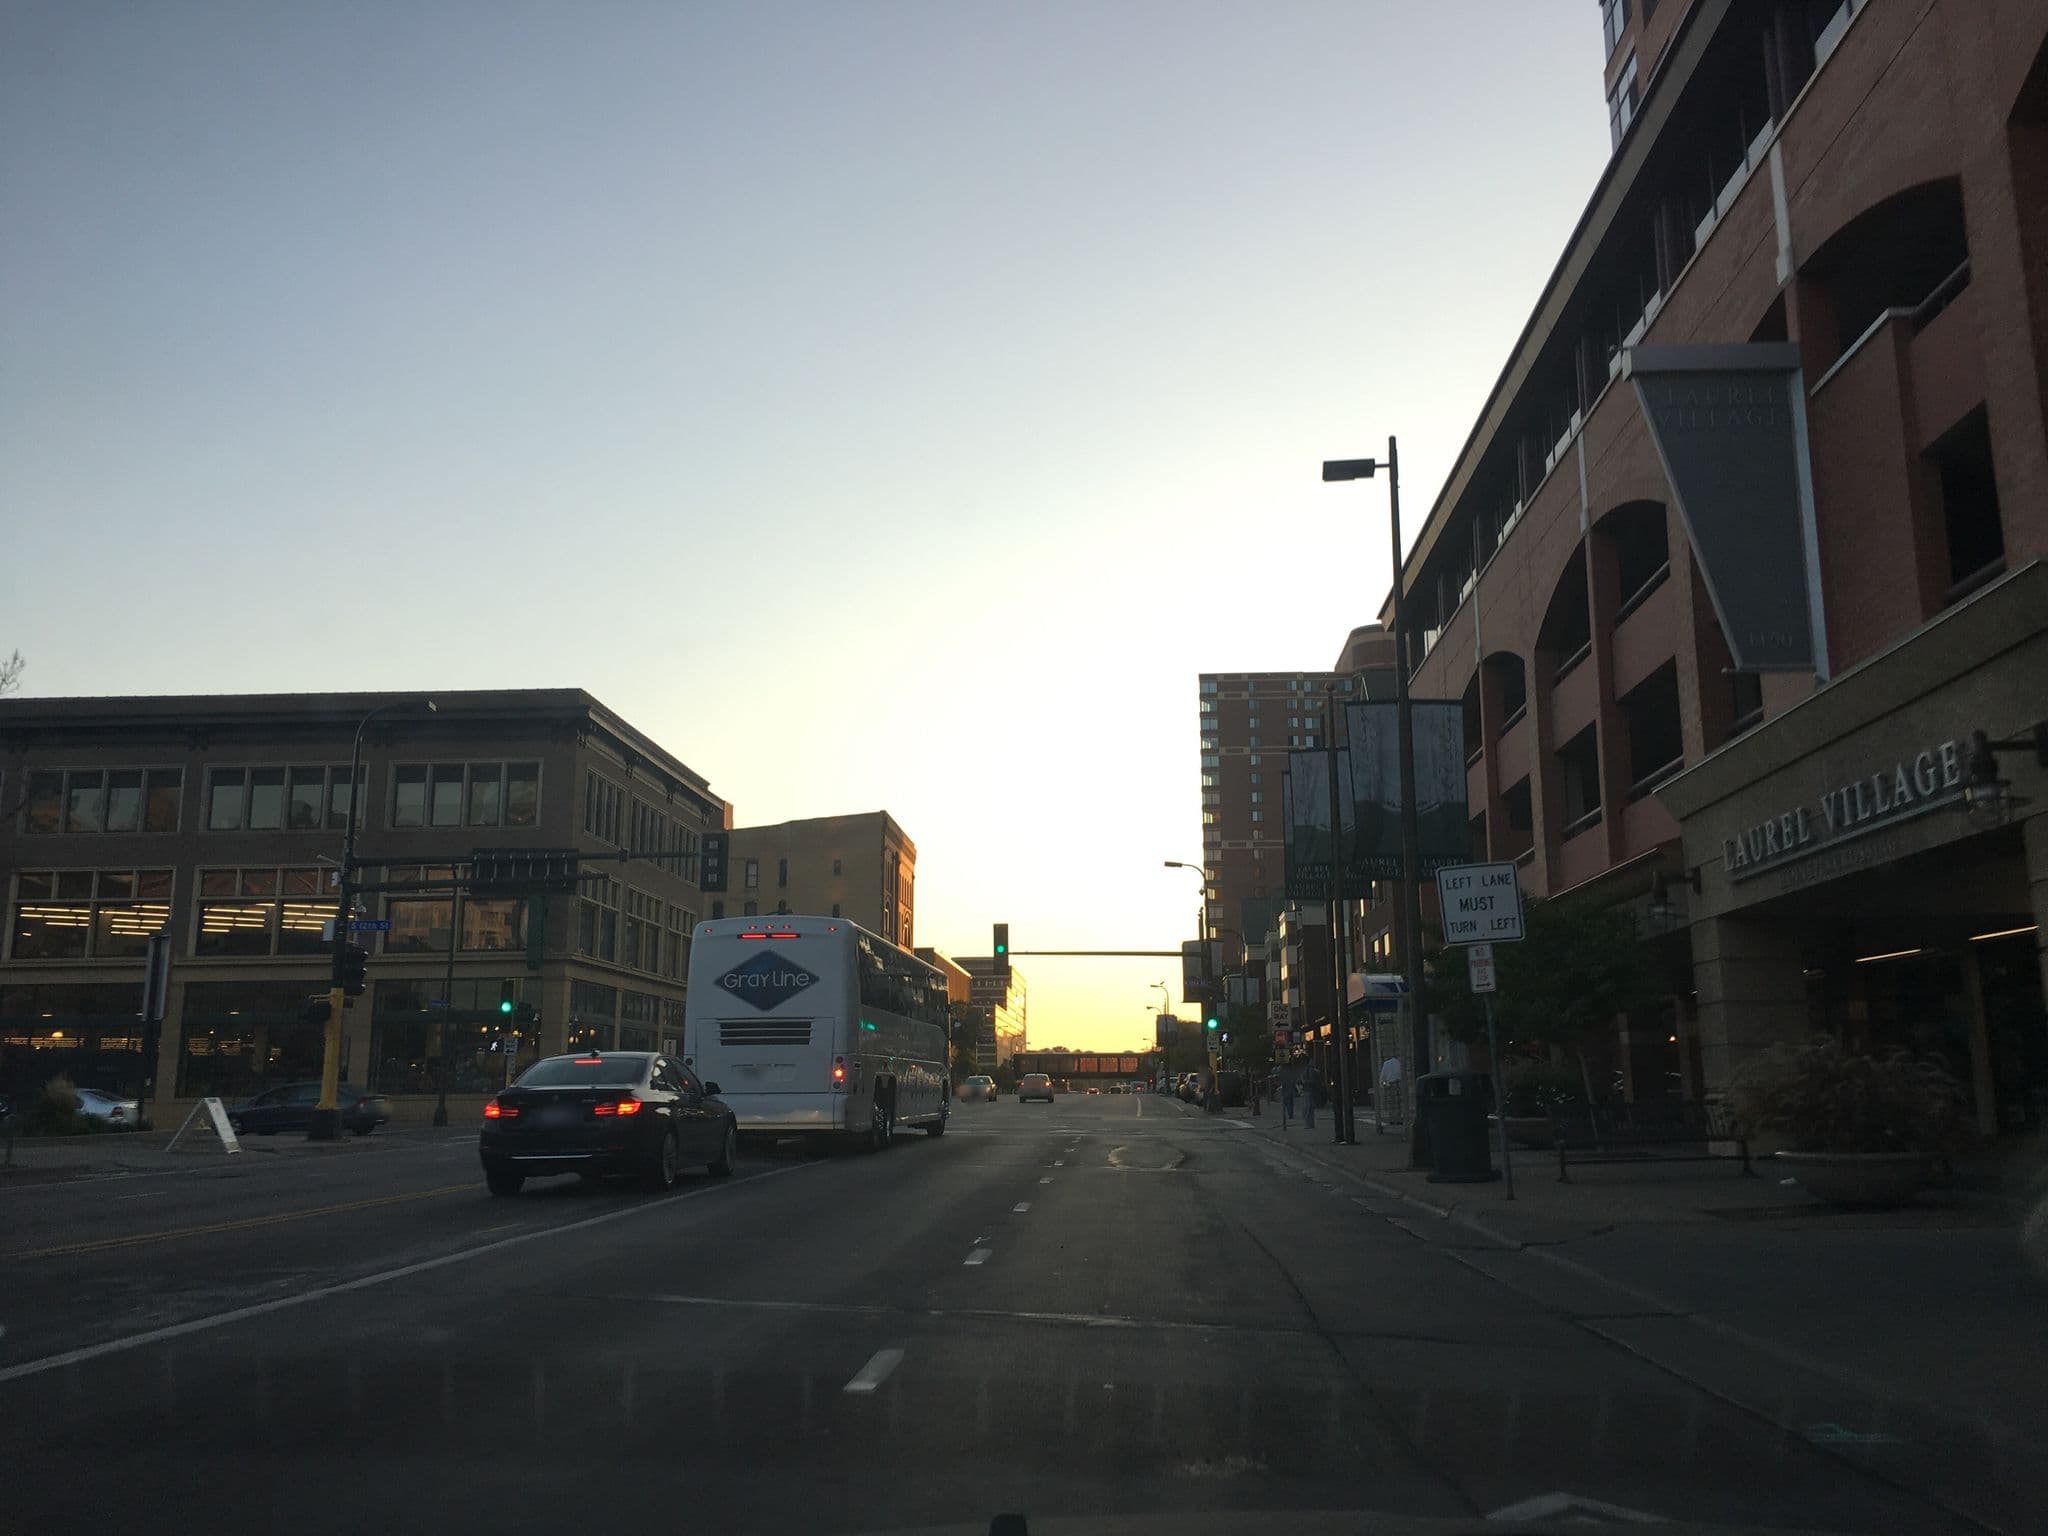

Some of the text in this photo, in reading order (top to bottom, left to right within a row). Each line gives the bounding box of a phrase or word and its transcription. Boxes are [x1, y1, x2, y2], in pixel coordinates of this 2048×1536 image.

[1722, 807, 1810, 872] LAUREL
[1821, 740, 1962, 832] VILLAGE
[1445, 873, 1513, 890] LEFT LANE
[1459, 896, 1495, 912] MUST
[1450, 917, 1517, 933] TURN LEFT
[724, 973, 770, 988] Gray
[1273, 1005, 1289, 1013] ONE
